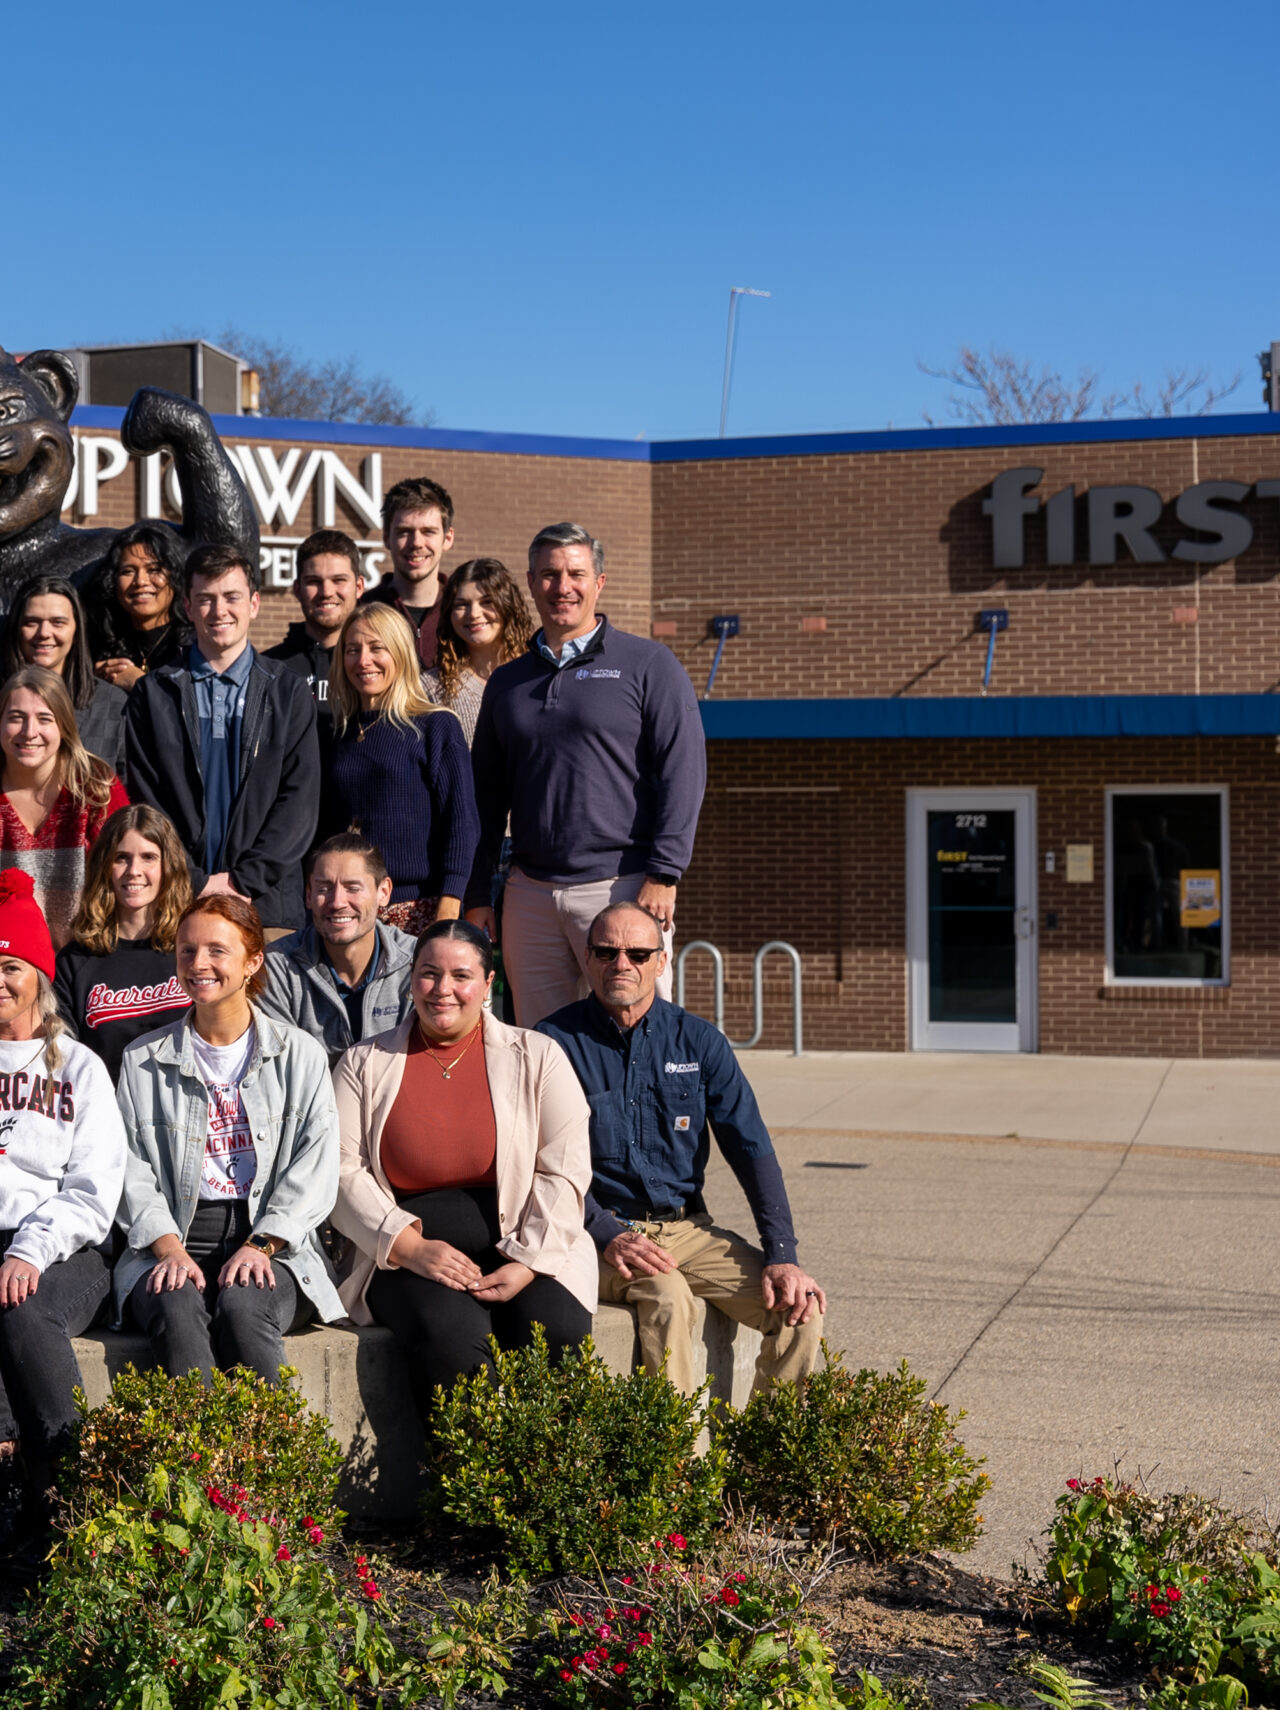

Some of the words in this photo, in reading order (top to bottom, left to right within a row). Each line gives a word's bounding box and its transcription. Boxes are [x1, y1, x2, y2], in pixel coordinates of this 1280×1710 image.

[61, 435, 383, 530] PTWN
[982, 466, 1280, 568] fIRS
[955, 814, 987, 828] 2712
